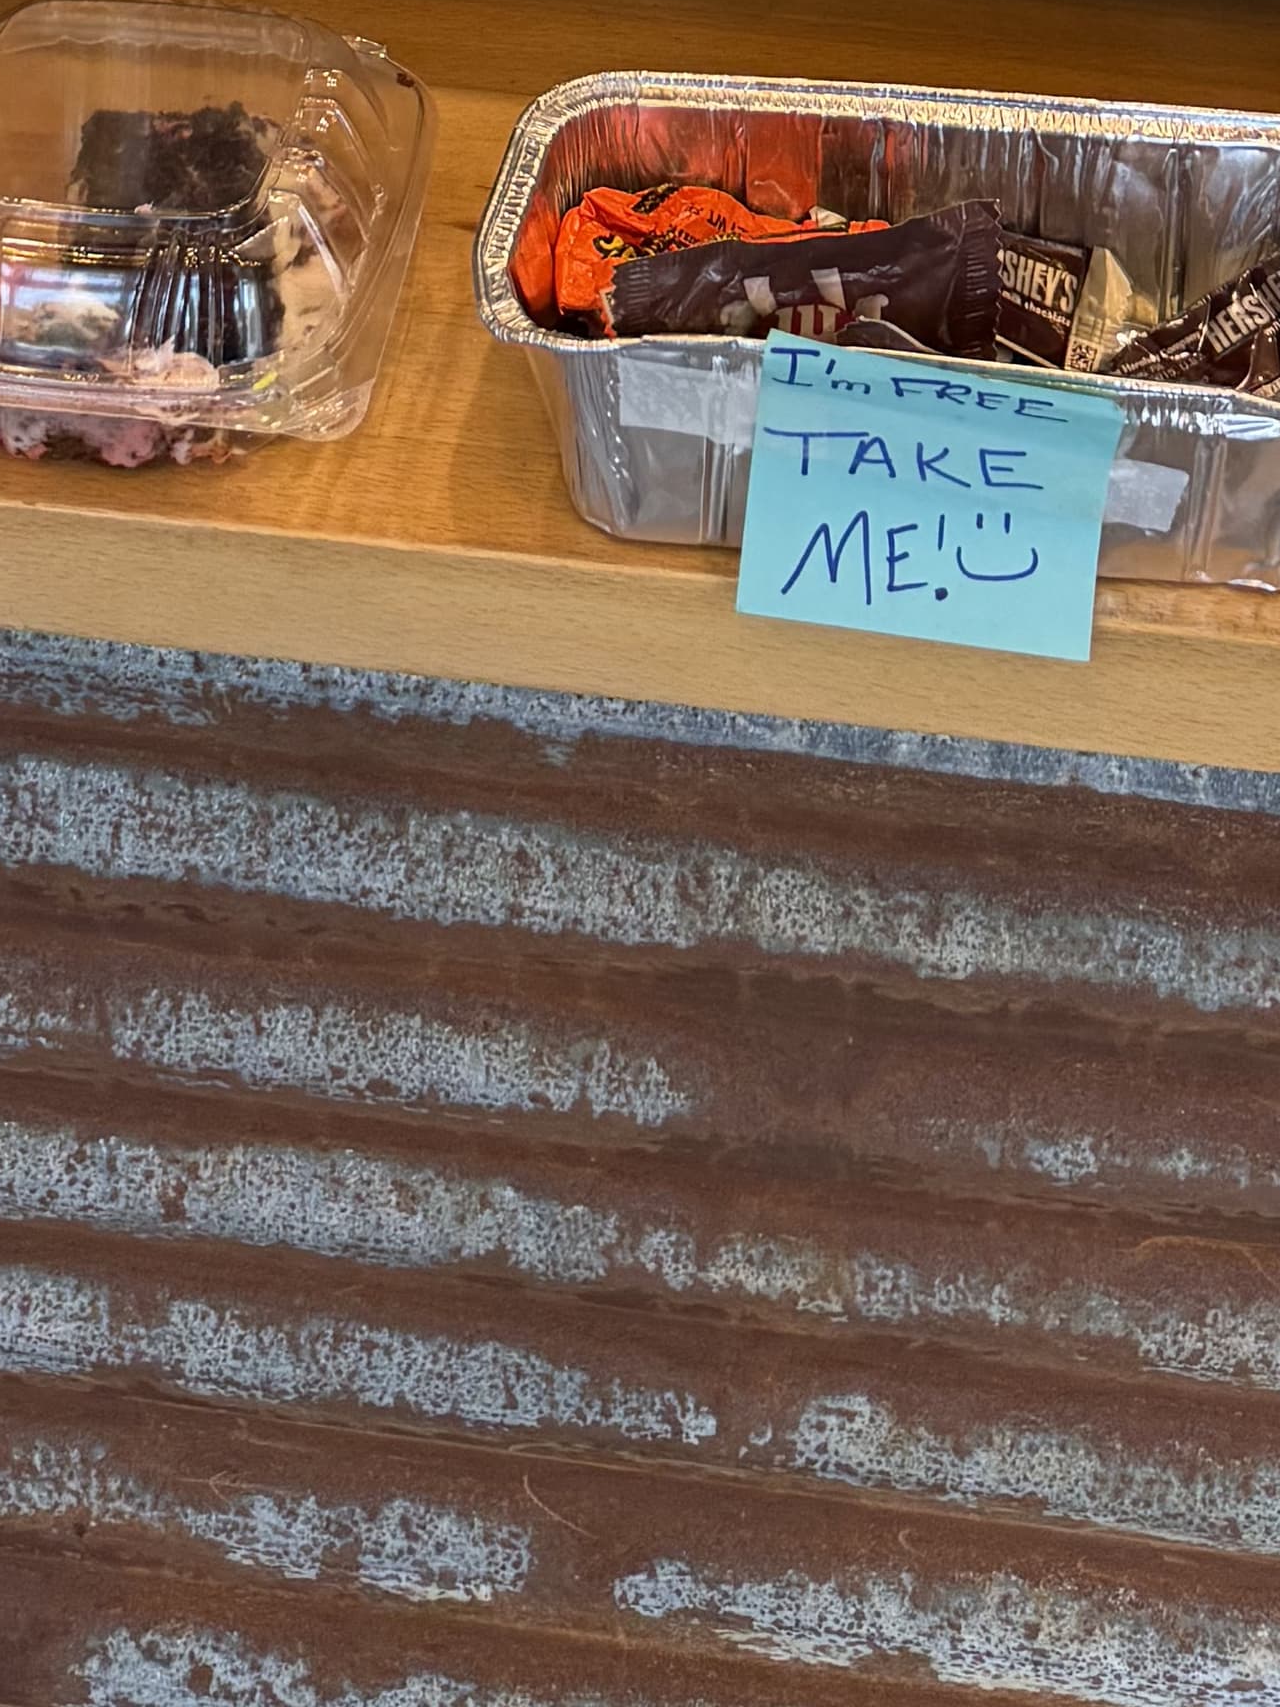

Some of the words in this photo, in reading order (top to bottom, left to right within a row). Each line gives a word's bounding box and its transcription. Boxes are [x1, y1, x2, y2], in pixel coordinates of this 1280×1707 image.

[1000, 249, 1079, 315] SHEY'S
[770, 347, 872, 395] I'm
[892, 376, 1069, 424] FREE
[764, 426, 1046, 492] TAKE
[780, 508, 952, 607] ME!
